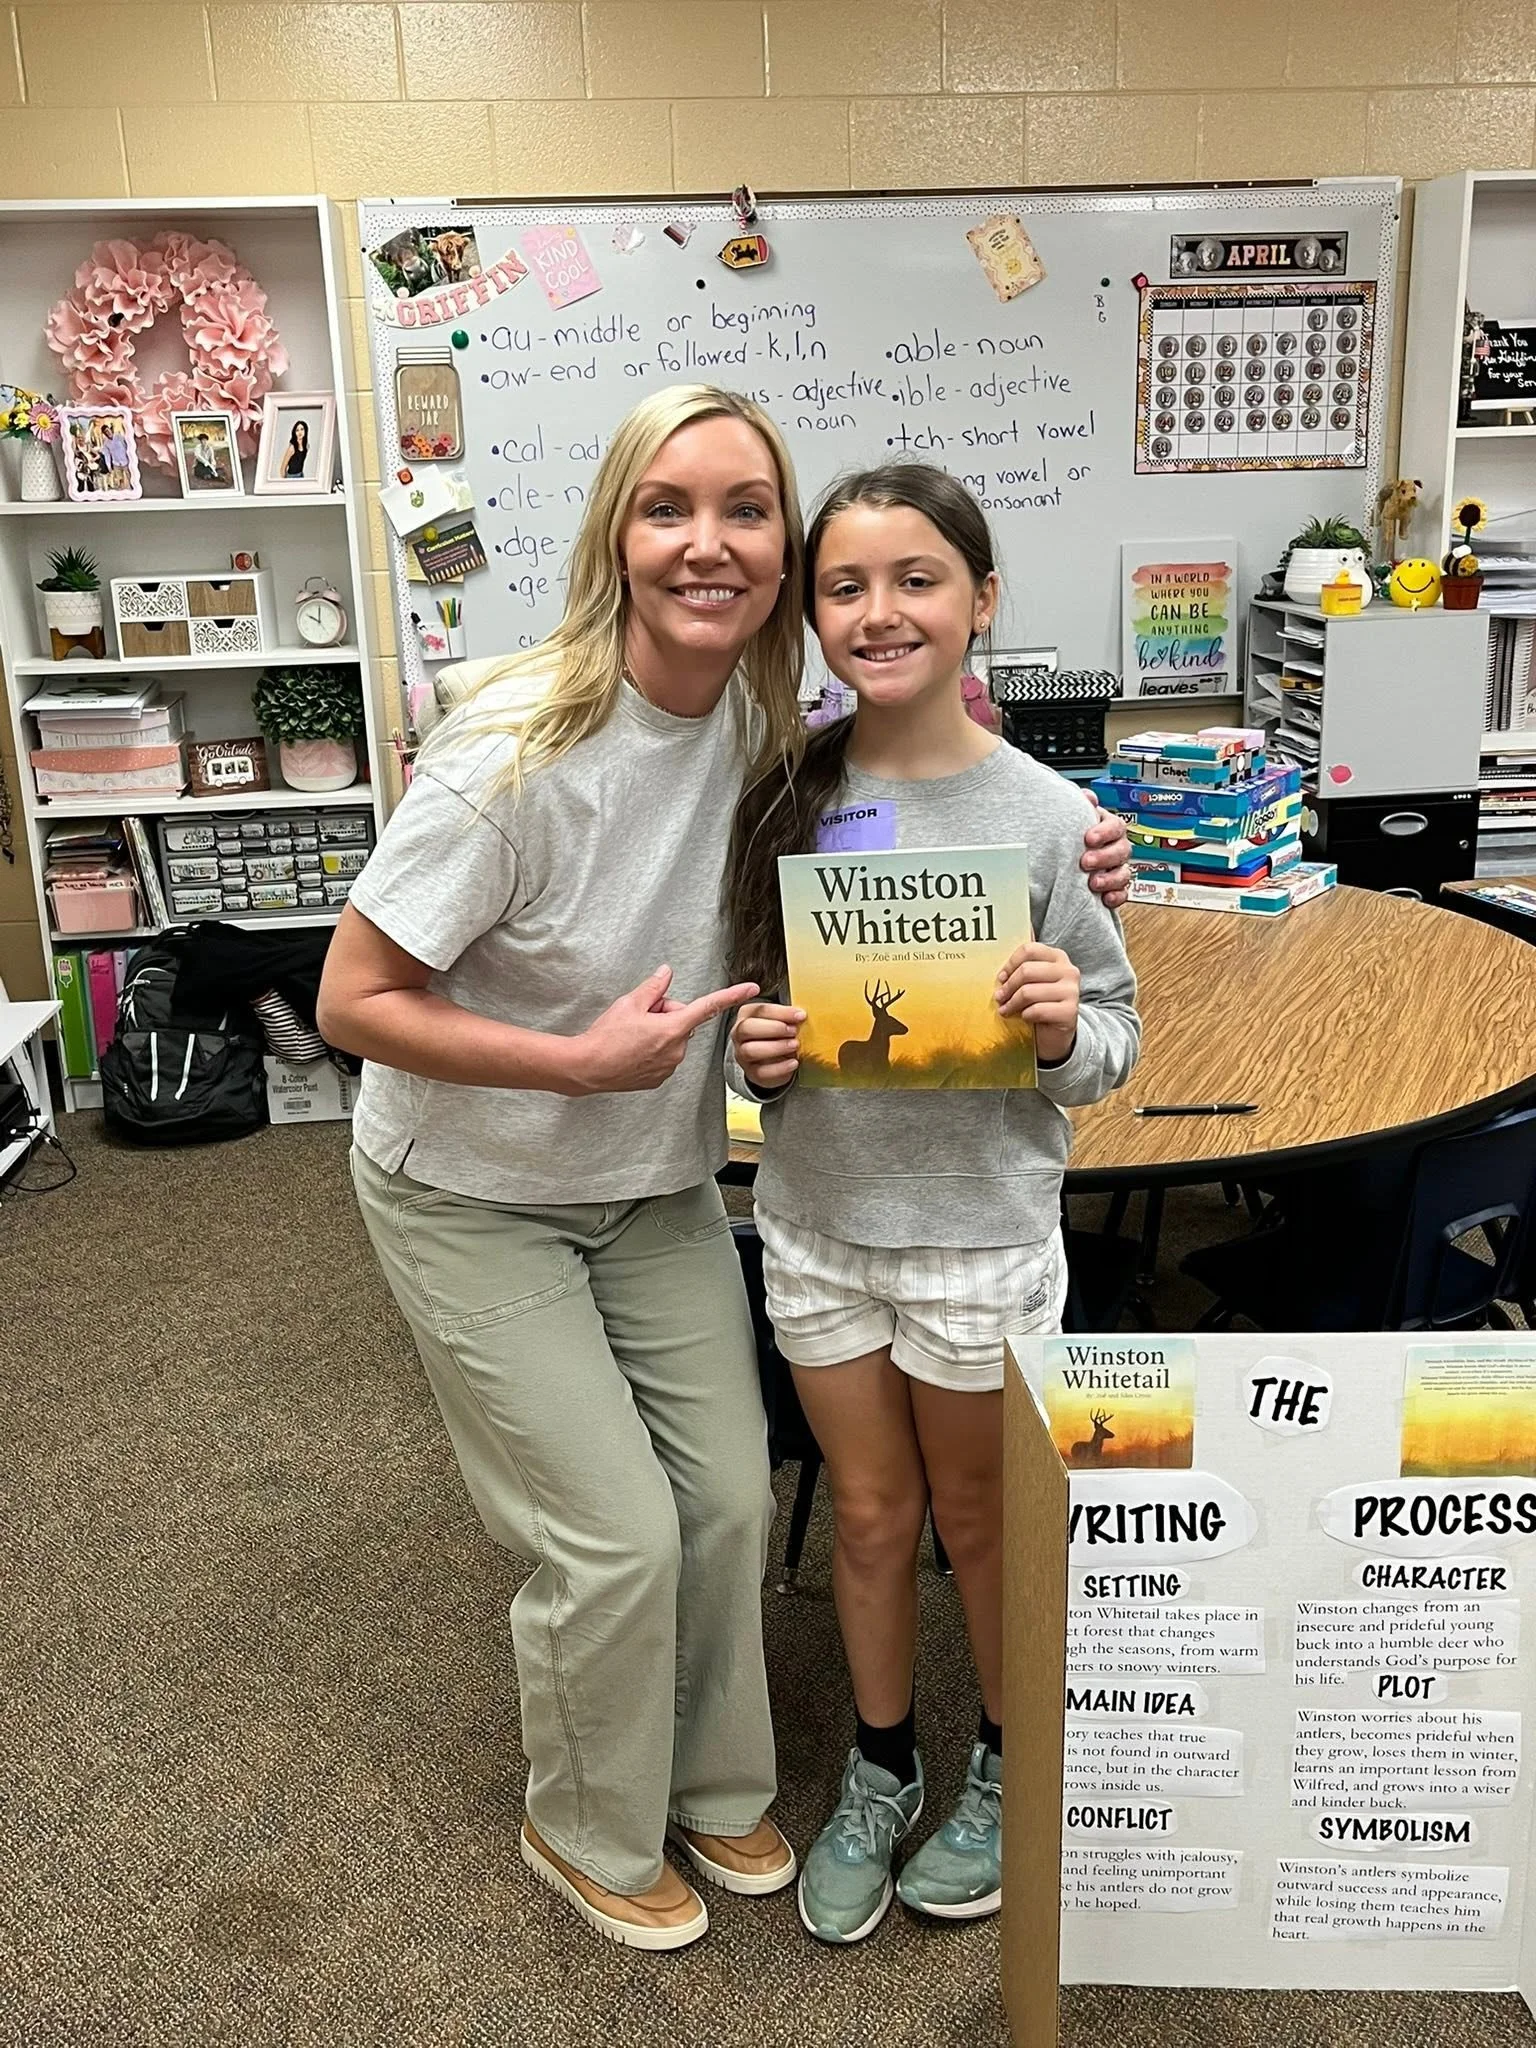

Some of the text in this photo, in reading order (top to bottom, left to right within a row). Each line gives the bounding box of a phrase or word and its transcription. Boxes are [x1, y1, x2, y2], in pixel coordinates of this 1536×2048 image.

[533, 240, 578, 272] KIND
[1227, 244, 1290, 266] APRIL
[546, 258, 589, 289] COOL
[397, 249, 529, 327] GRIFFIN
[667, 315, 692, 333] or
[712, 303, 816, 334] beginning
[1510, 333, 1528, 347] You
[624, 360, 650, 378] or
[1503, 372, 1524, 382] your
[408, 395, 448, 411] REWARD
[421, 411, 439, 426] JAR
[1037, 410, 1095, 440] vowel
[996, 457, 1047, 485] vowel
[1068, 465, 1091, 481] or
[1151, 573, 1209, 584] IN A WORLD
[1151, 588, 1209, 599] WHERE YOU
[1151, 603, 1209, 620] CAN BE
[1151, 624, 1209, 635] ANYTHING
[1139, 637, 1224, 670] be kind
[1143, 683, 1199, 696] leaves
[820, 808, 878, 827] VISITOR
[814, 866, 986, 903] Winston
[811, 904, 998, 946] Whitetail
[855, 953, 870, 963] By:
[892, 951, 910, 961] and
[913, 951, 935, 961] Silas
[938, 950, 966, 960] Cross
[1066, 1345, 1165, 1366] Winston
[1062, 1368, 1170, 1389] Whitetail
[1250, 1377, 1328, 1426] THE
[1354, 1492, 1536, 1538] PROCESS
[1083, 1573, 1181, 1598] SETTING
[1362, 1564, 1507, 1590] CHARACTER
[1097, 1607, 1159, 1619] Whitetail
[1165, 1609, 1200, 1621] takes
[1204, 1610, 1240, 1625] place
[1245, 1609, 1258, 1620] in
[1298, 1600, 1480, 1617] Winston changes from an
[1084, 1624, 1124, 1637] forest
[1129, 1625, 1155, 1637] that
[1160, 1626, 1215, 1642] changes
[1297, 1619, 1494, 1635] insecure and prideful young
[1296, 1635, 1504, 1650] buck into a humble deer who
[1296, 1655, 1380, 1669] understands
[1433, 1657, 1490, 1671] purpose
[1497, 1653, 1517, 1664] for
[1296, 1673, 1344, 1686] his life.
[1378, 1675, 1436, 1699] PLOT
[1065, 1688, 1195, 1715] MAIN IDEA
[1298, 1711, 1482, 1725] Winston worries about his
[1094, 1728, 1143, 1741] teaches
[1148, 1729, 1174, 1742] that
[1180, 1734, 1206, 1743] true
[1296, 1727, 1514, 1745] antlers, becomes prideful when
[1296, 1744, 1518, 1763] they grow, loses them in winter,
[1293, 1761, 1516, 1778] learns an important lesson from
[1067, 1806, 1173, 1830] CONFLICT
[1319, 1817, 1471, 1843] SYMBOLISM
[1082, 1849, 1143, 1862] struggles
[1146, 1850, 1176, 1862] with
[1180, 1850, 1237, 1865] jealousy,
[1063, 1864, 1226, 1881] and feeling unimportant
[1351, 1866, 1396, 1878] antlers
[1401, 1868, 1469, 1883] symbolize
[1277, 1880, 1502, 1904] outward success and appearance,
